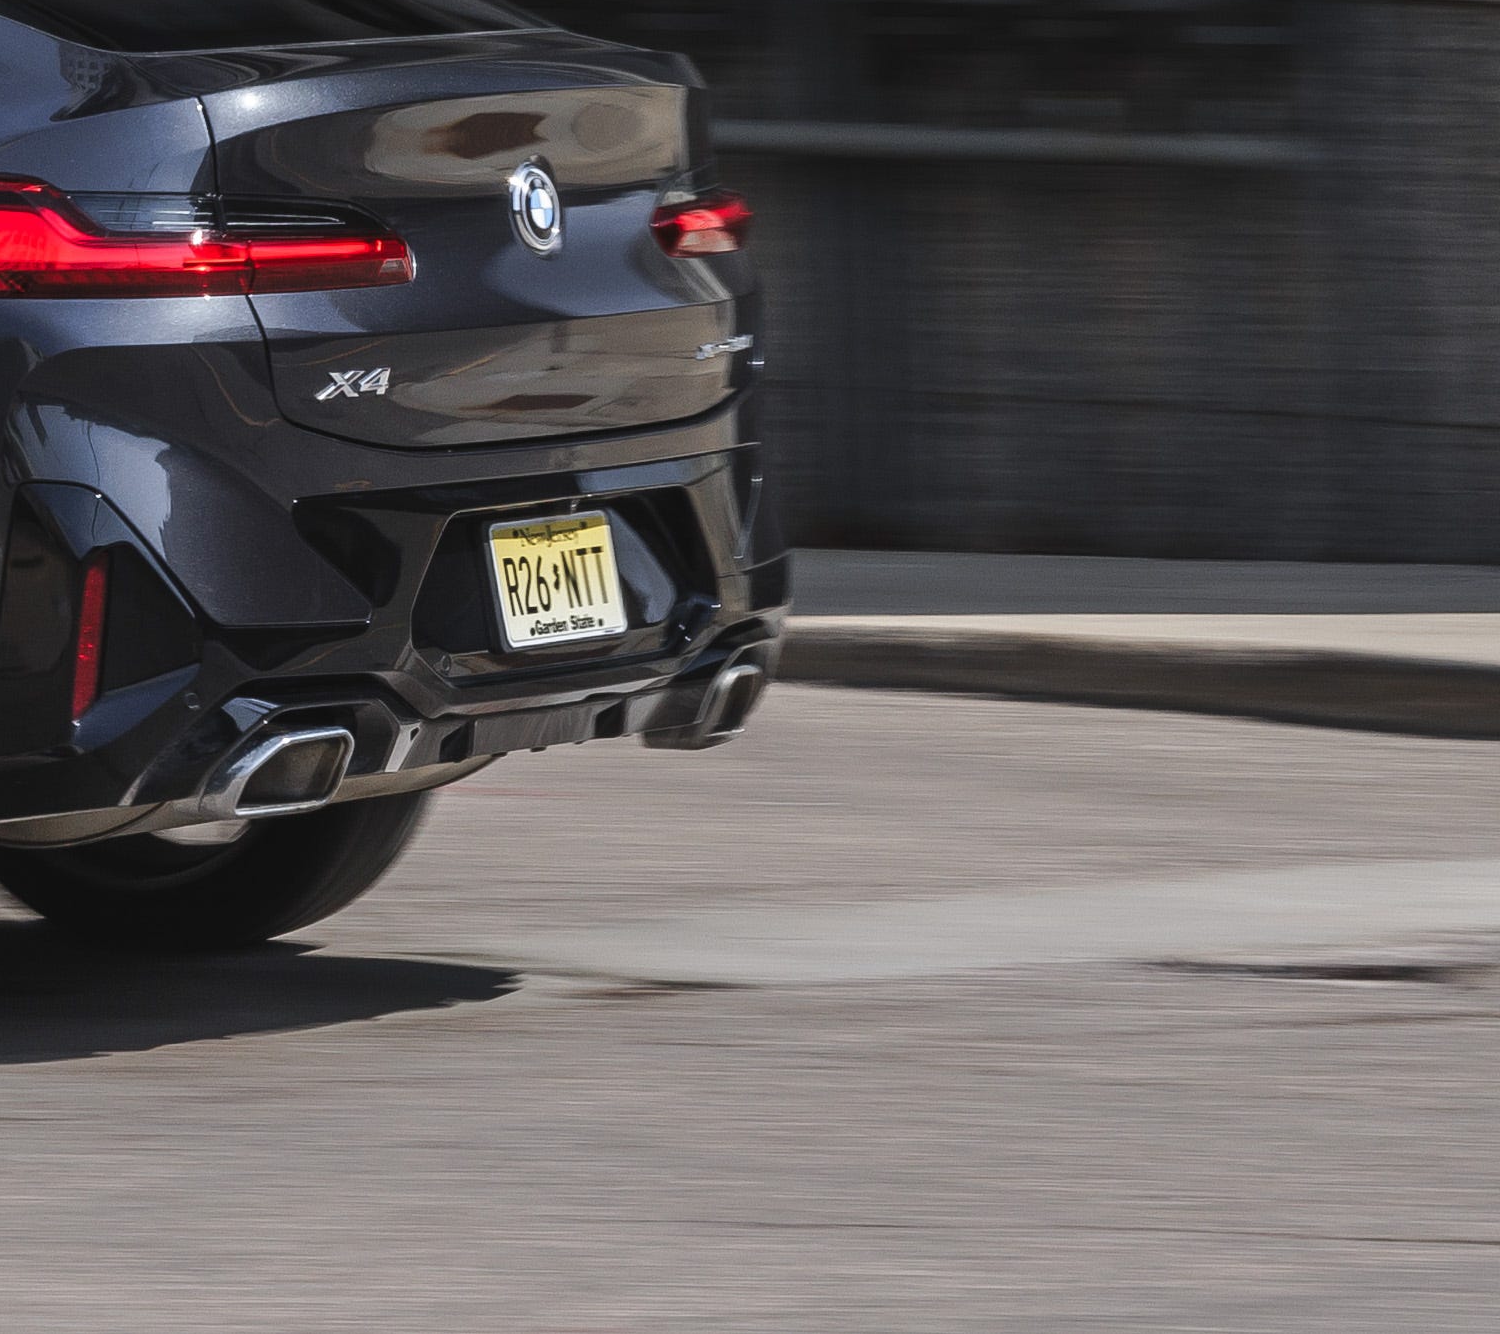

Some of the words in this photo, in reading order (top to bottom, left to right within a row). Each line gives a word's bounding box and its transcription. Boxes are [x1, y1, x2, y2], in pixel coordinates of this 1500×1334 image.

[314, 367, 391, 402] X4
[535, 617, 569, 635] Garden
[570, 614, 596, 630] State
